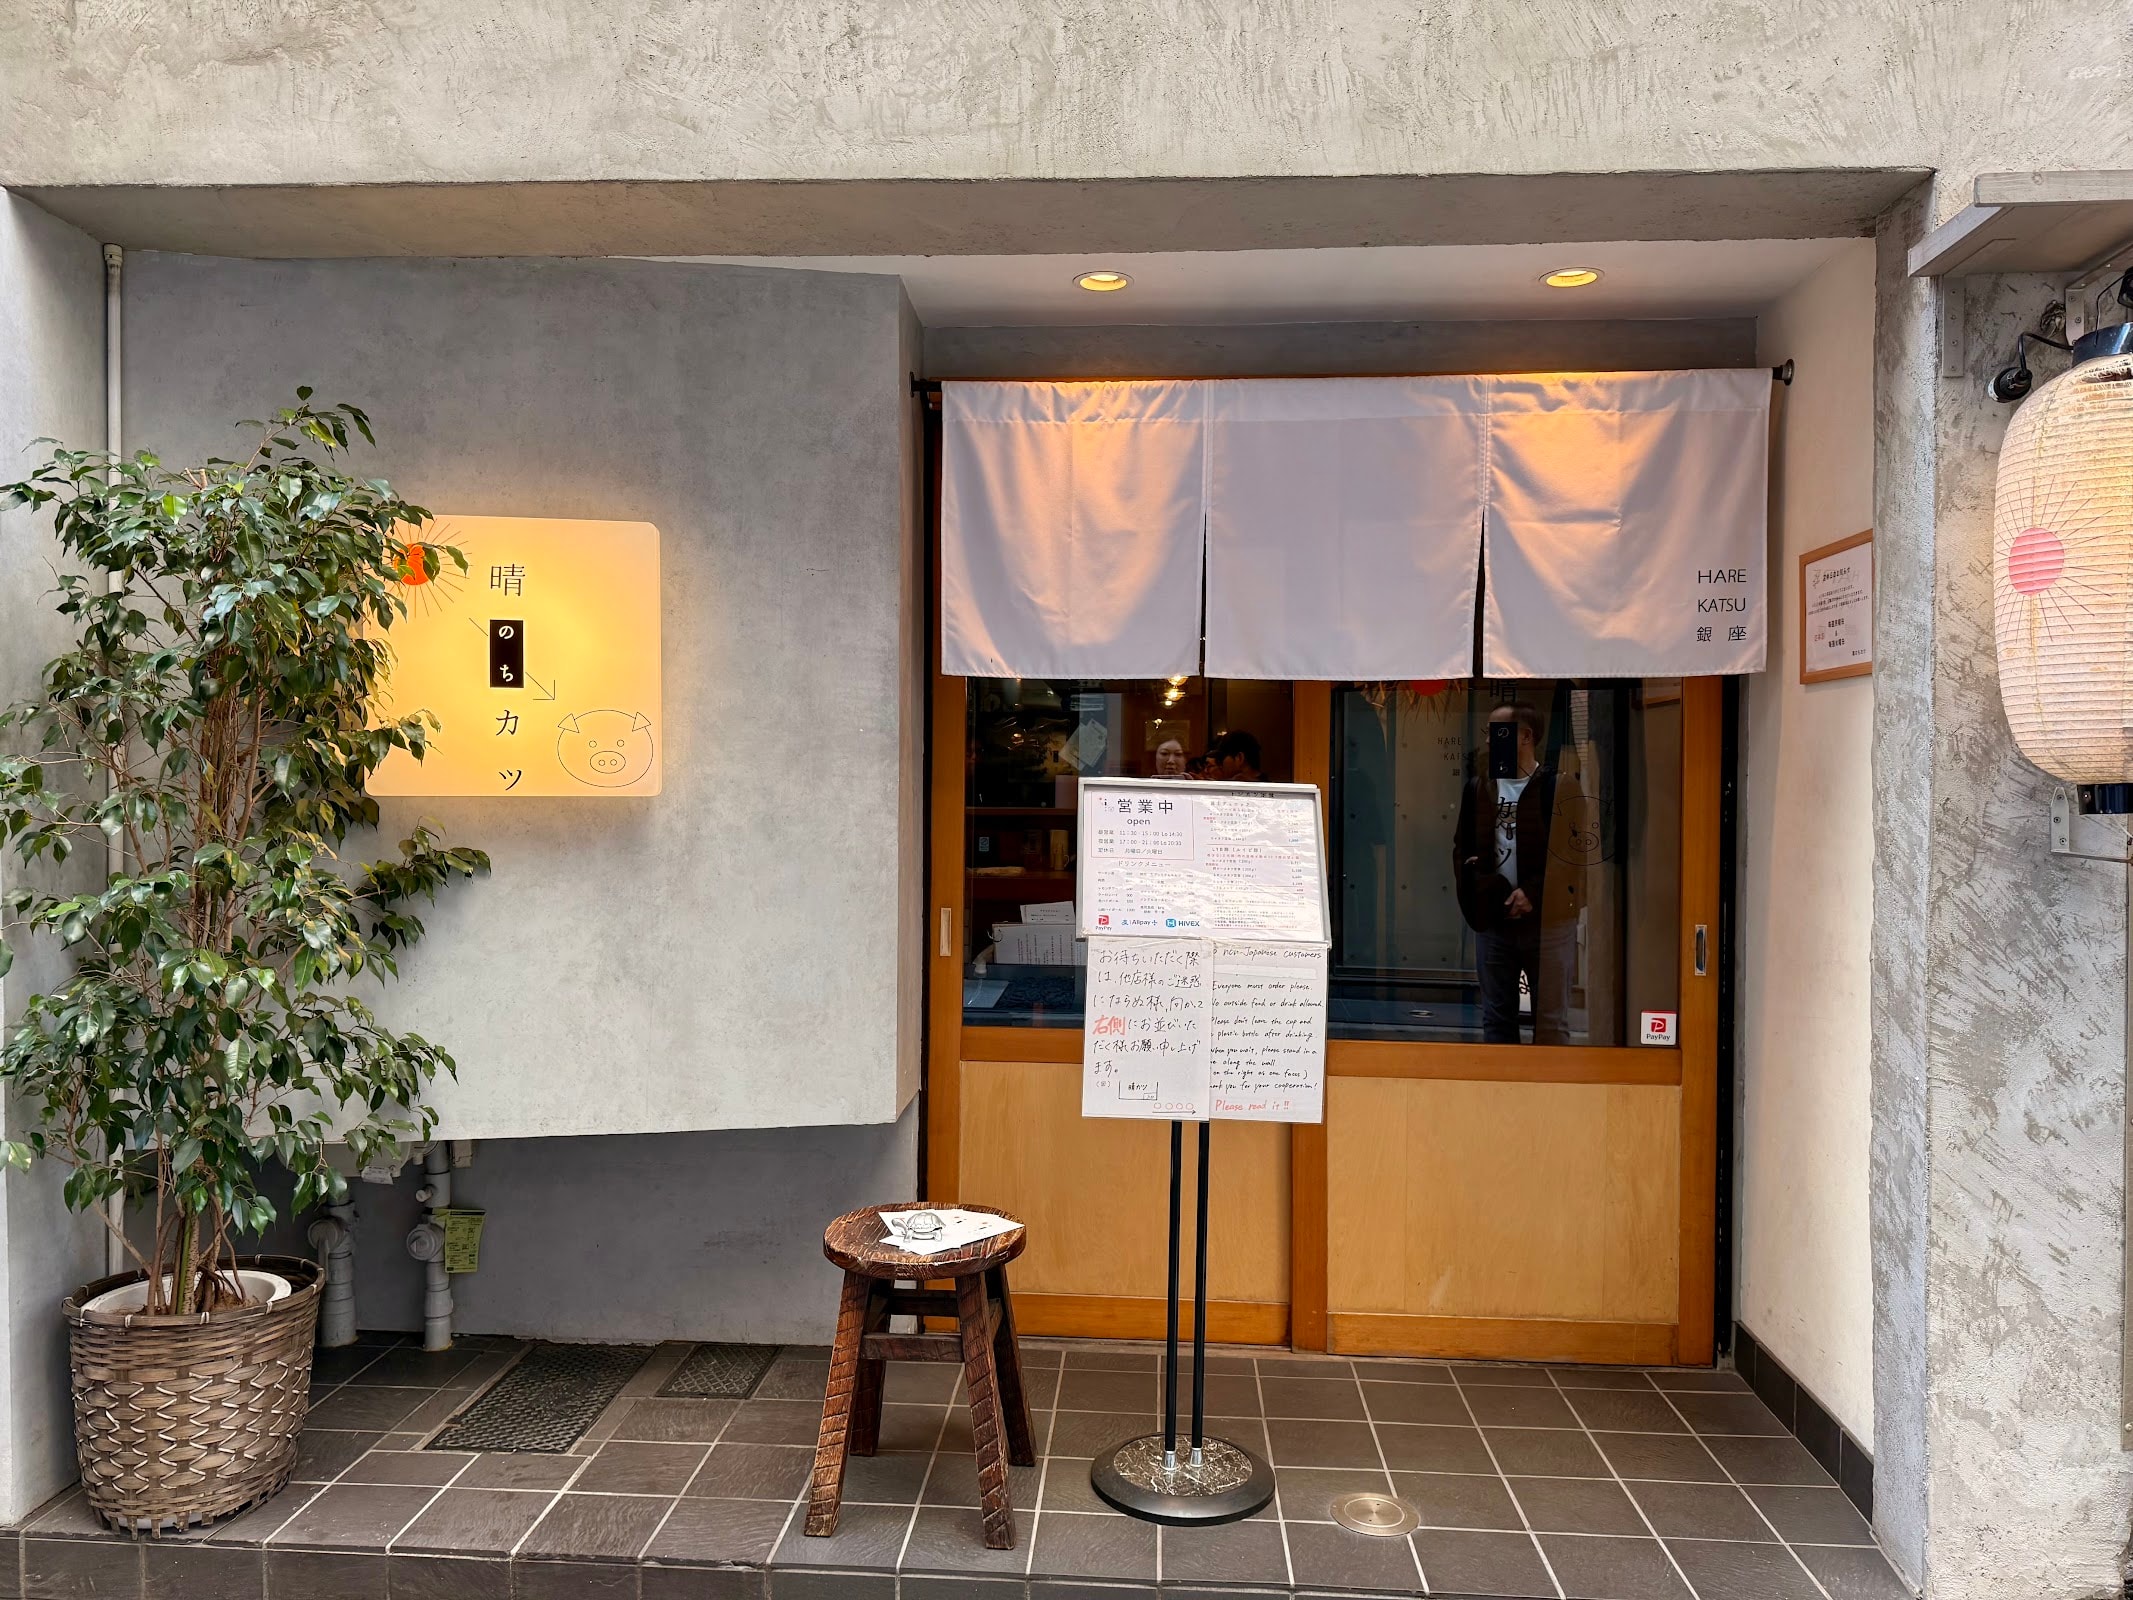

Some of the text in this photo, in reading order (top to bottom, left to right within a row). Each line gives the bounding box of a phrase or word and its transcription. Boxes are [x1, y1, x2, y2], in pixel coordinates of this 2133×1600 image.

[1698, 569, 1747, 584] HARE
[1697, 597, 1746, 613] KATSU
[1696, 625, 1747, 642] 銀座
[1117, 798, 1173, 815] 営業中
[1126, 818, 1151, 826] open
[1099, 950, 1201, 970] お待ちいただく際
[1223, 947, 1277, 960] non-Japanese
[1283, 949, 1322, 958] customers
[1213, 980, 1241, 993] Everyone
[1268, 981, 1285, 989] order
[1223, 998, 1248, 1006] outside
[1251, 997, 1265, 1008] food
[1280, 998, 1297, 1007] drink
[1092, 1014, 1197, 1036] 右側にお並びいた
[1234, 1015, 1248, 1025] don't
[1271, 1017, 1282, 1025] the
[1285, 1019, 1296, 1029] cup
[1299, 1017, 1312, 1025] and
[1264, 1029, 1281, 1038] after
[1227, 1048, 1238, 1056] you
[1262, 1046, 1280, 1055] please
[1222, 1058, 1241, 1070] along
[1237, 1070, 1253, 1079] right
[1225, 1084, 1236, 1094] you
[1240, 1081, 1251, 1090] for
[1254, 1084, 1270, 1093] your
[1215, 1100, 1243, 1112] Please
[1248, 1100, 1267, 1110] read
